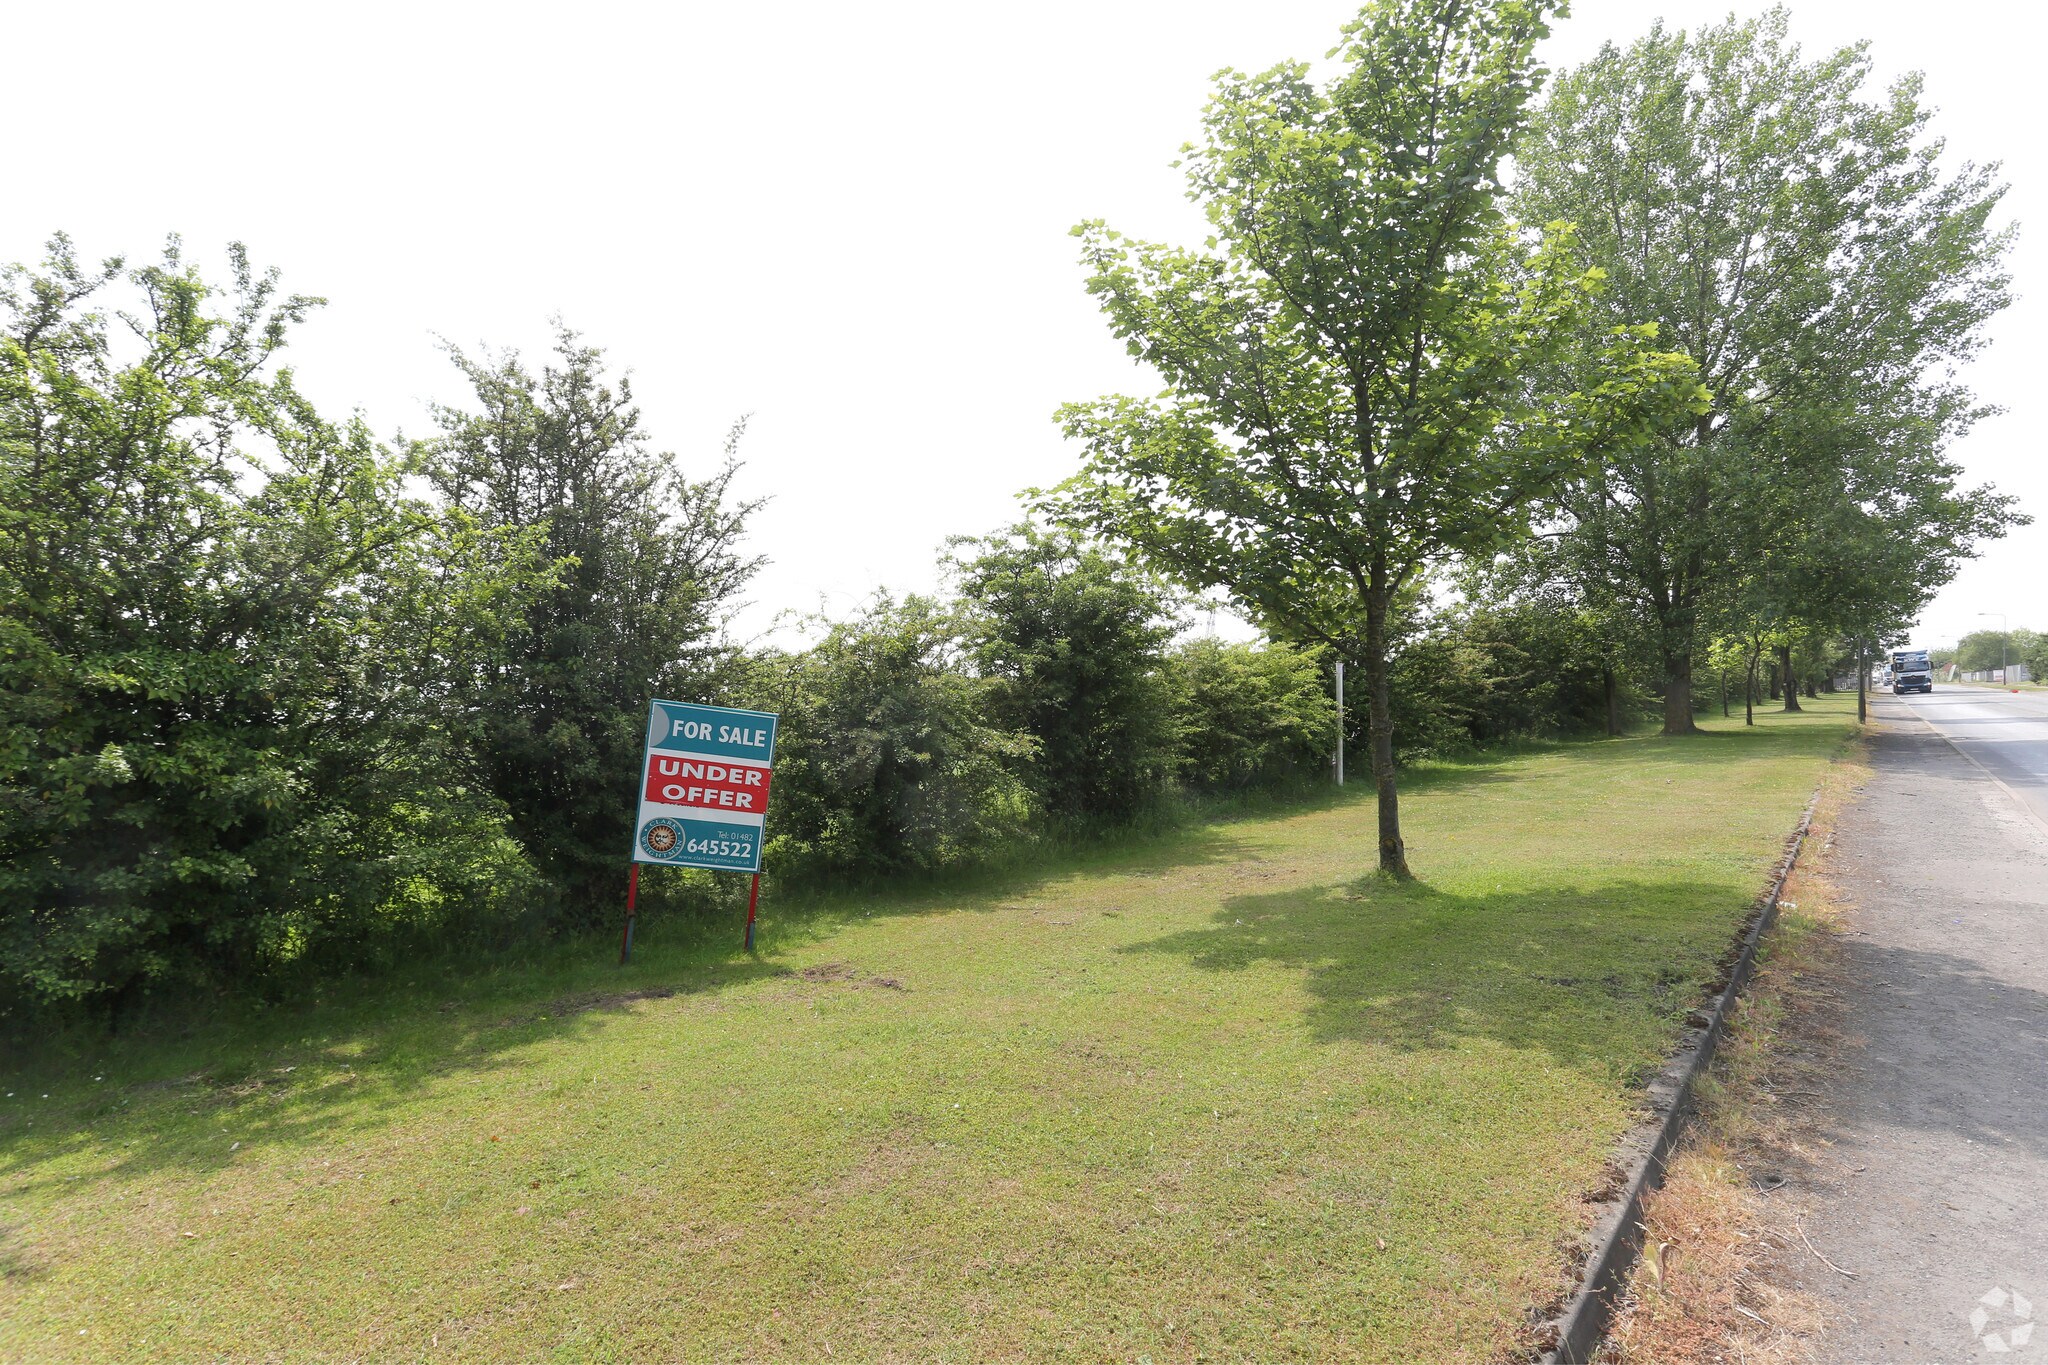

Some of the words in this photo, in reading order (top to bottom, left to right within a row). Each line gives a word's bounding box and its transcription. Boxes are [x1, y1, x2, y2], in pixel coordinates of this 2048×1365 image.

[672, 719, 712, 741] FOR
[718, 725, 767, 747] SALE
[659, 759, 763, 786] UNDER
[662, 783, 753, 808] OFFER
[649, 819, 678, 830] CLARK
[641, 835, 683, 858] WEIGHTMAN
[687, 838, 751, 858] 645522
[717, 831, 729, 839] Tel:
[730, 832, 753, 842] 01482
